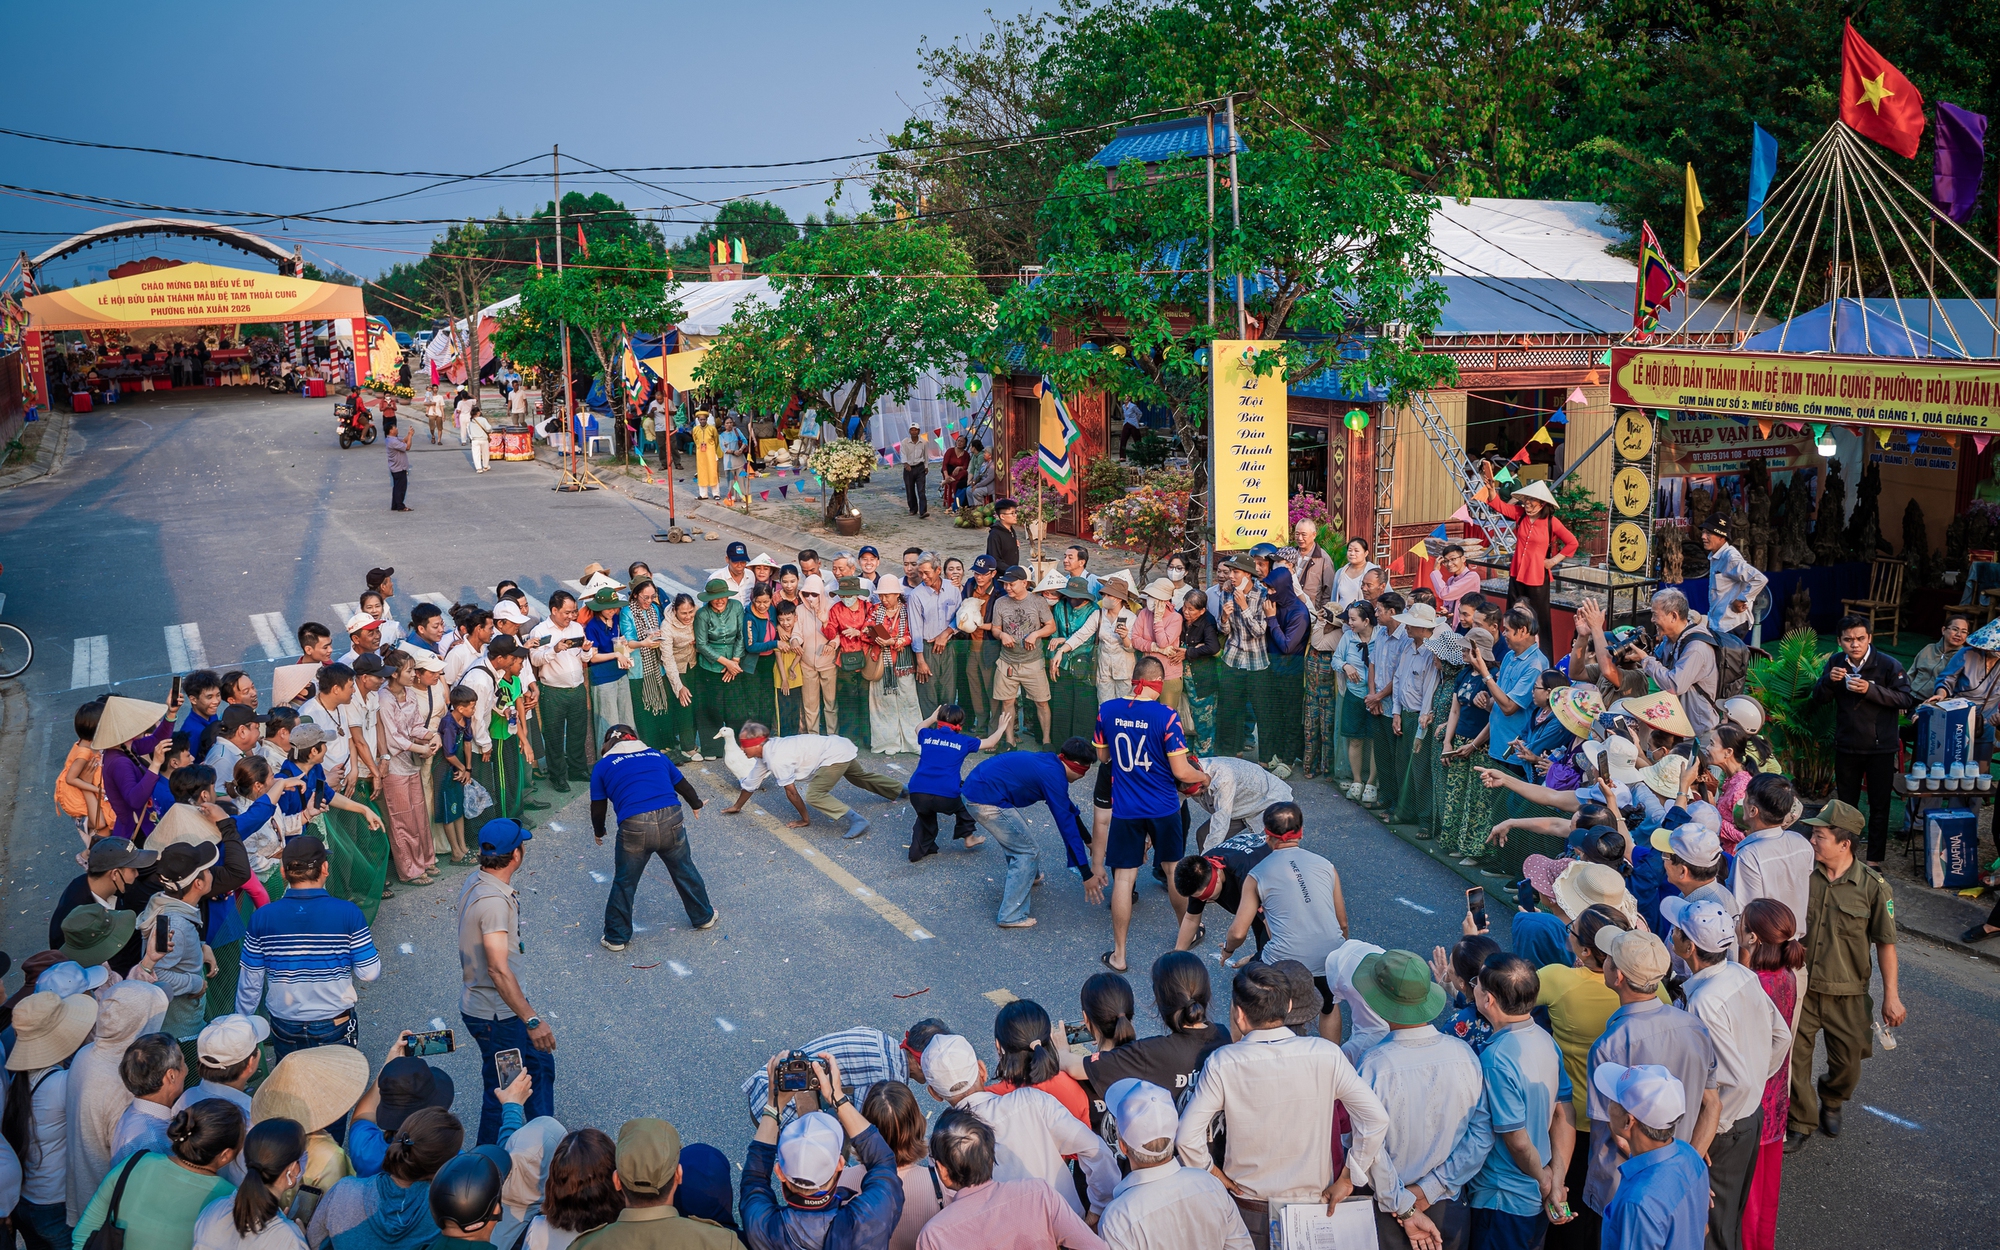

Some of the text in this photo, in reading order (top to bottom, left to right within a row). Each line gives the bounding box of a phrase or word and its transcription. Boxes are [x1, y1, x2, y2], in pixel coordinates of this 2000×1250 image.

[141, 278, 255, 290] CHÀO MỪNG ĐẠI BIỂU VỀ DỰ
[98, 294, 108, 305] LỄ
[110, 296, 126, 306] HỘI
[167, 292, 195, 302] THÁNH
[197, 290, 216, 302] MẪU
[217, 292, 229, 301] ĐỆ
[230, 291, 248, 300] TAM
[250, 289, 273, 300] THOẢI
[275, 290, 297, 299] CUNG
[151, 302, 251, 316] PHƯỜNG HÒA XUÂN 2026
[1242, 379, 1259, 390] Lễ
[1633, 357, 1643, 385] LỄ
[1645, 362, 1660, 390] HỘI
[1662, 359, 1681, 388] BỬU
[1683, 360, 1703, 388] ĐẢN
[1705, 364, 1737, 391] THÁNH
[1739, 362, 1762, 392] MẪU
[1765, 366, 1778, 398] ĐỆ
[1782, 372, 1803, 395] TAM
[1806, 366, 1837, 398] THOẢI
[1840, 374, 1871, 400] CUNG
[1874, 372, 1923, 403] PHƯỜNG
[1926, 373, 1950, 404] HÒA
[1954, 376, 1991, 407] XUÂN
[1239, 396, 1264, 407] Hội
[1678, 395, 1696, 407] CỤM
[1698, 395, 1714, 406] DÂN
[1716, 396, 1728, 407] CƯ
[1729, 396, 1740, 408] SỐ
[1742, 400, 1750, 409] 3:
[1752, 398, 1773, 411] MIẾU
[1856, 407, 1876, 419] QUÁ
[1878, 408, 1908, 422] GIÁNG
[1922, 412, 1942, 424] QUÁ
[1945, 412, 1978, 426] GIÁNG
[1980, 416, 1988, 427] 2
[1717, 426, 1751, 444] VẠN
[1230, 445, 1272, 455] Thánh
[1703, 451, 1717, 460] 0975
[1719, 451, 1729, 460] 014
[1731, 450, 1742, 459] 108
[1747, 448, 1761, 457] 0702
[1763, 448, 1774, 456] 528
[1775, 447, 1786, 455] 644
[1932, 446, 1952, 456] MONG
[1236, 461, 1265, 472] Mẫu
[1914, 456, 1927, 467] QUÁ
[1952, 462, 1957, 470] 2
[1242, 477, 1261, 489] Đệ
[1238, 494, 1266, 504] Tam
[1236, 526, 1268, 537] Cung
[1115, 718, 1148, 729] Phạm Bảo
[1955, 723, 1964, 762] AQUAFINA
[1115, 732, 1153, 772] 04
[1951, 833, 1964, 876] AQUAFINA
[1289, 860, 1311, 904] NIKE RUNNING
[1175, 1069, 1200, 1088] ĐỨ
[804, 1195, 830, 1205] Canon
